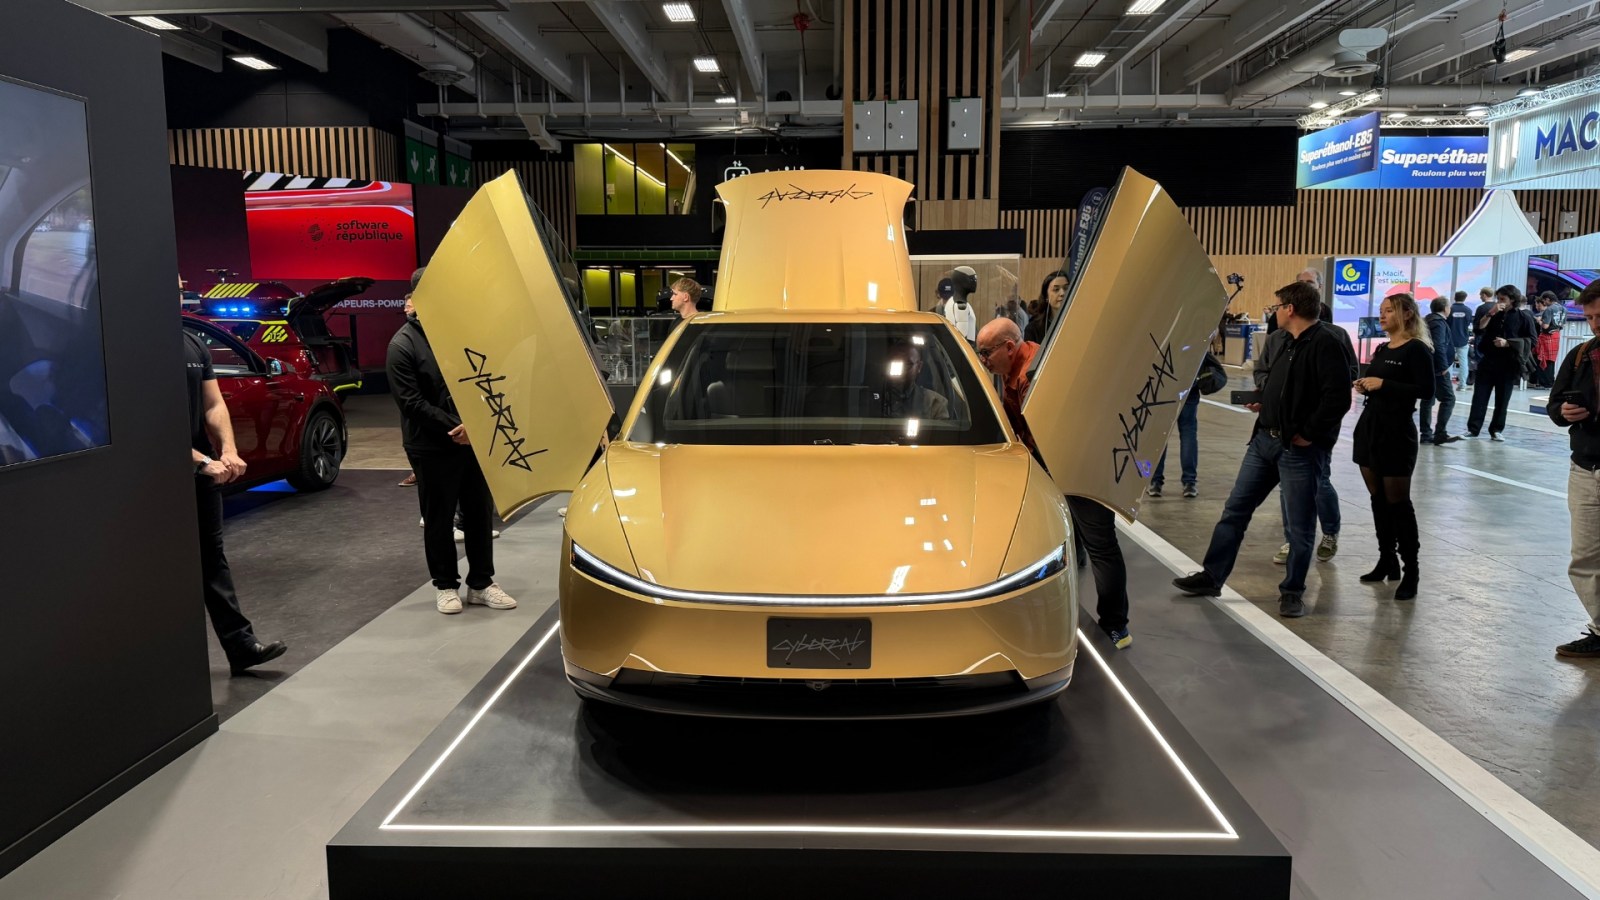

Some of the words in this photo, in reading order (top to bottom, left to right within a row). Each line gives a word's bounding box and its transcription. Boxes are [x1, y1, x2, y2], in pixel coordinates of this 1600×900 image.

[1535, 111, 1600, 160] MAC
[1300, 129, 1373, 165] Superéthanol-E85
[1448, 170, 1466, 178] plus
[336, 220, 389, 230] software
[336, 230, 403, 243] république
[1335, 283, 1366, 292] MACIF
[269, 332, 281, 341] 112
